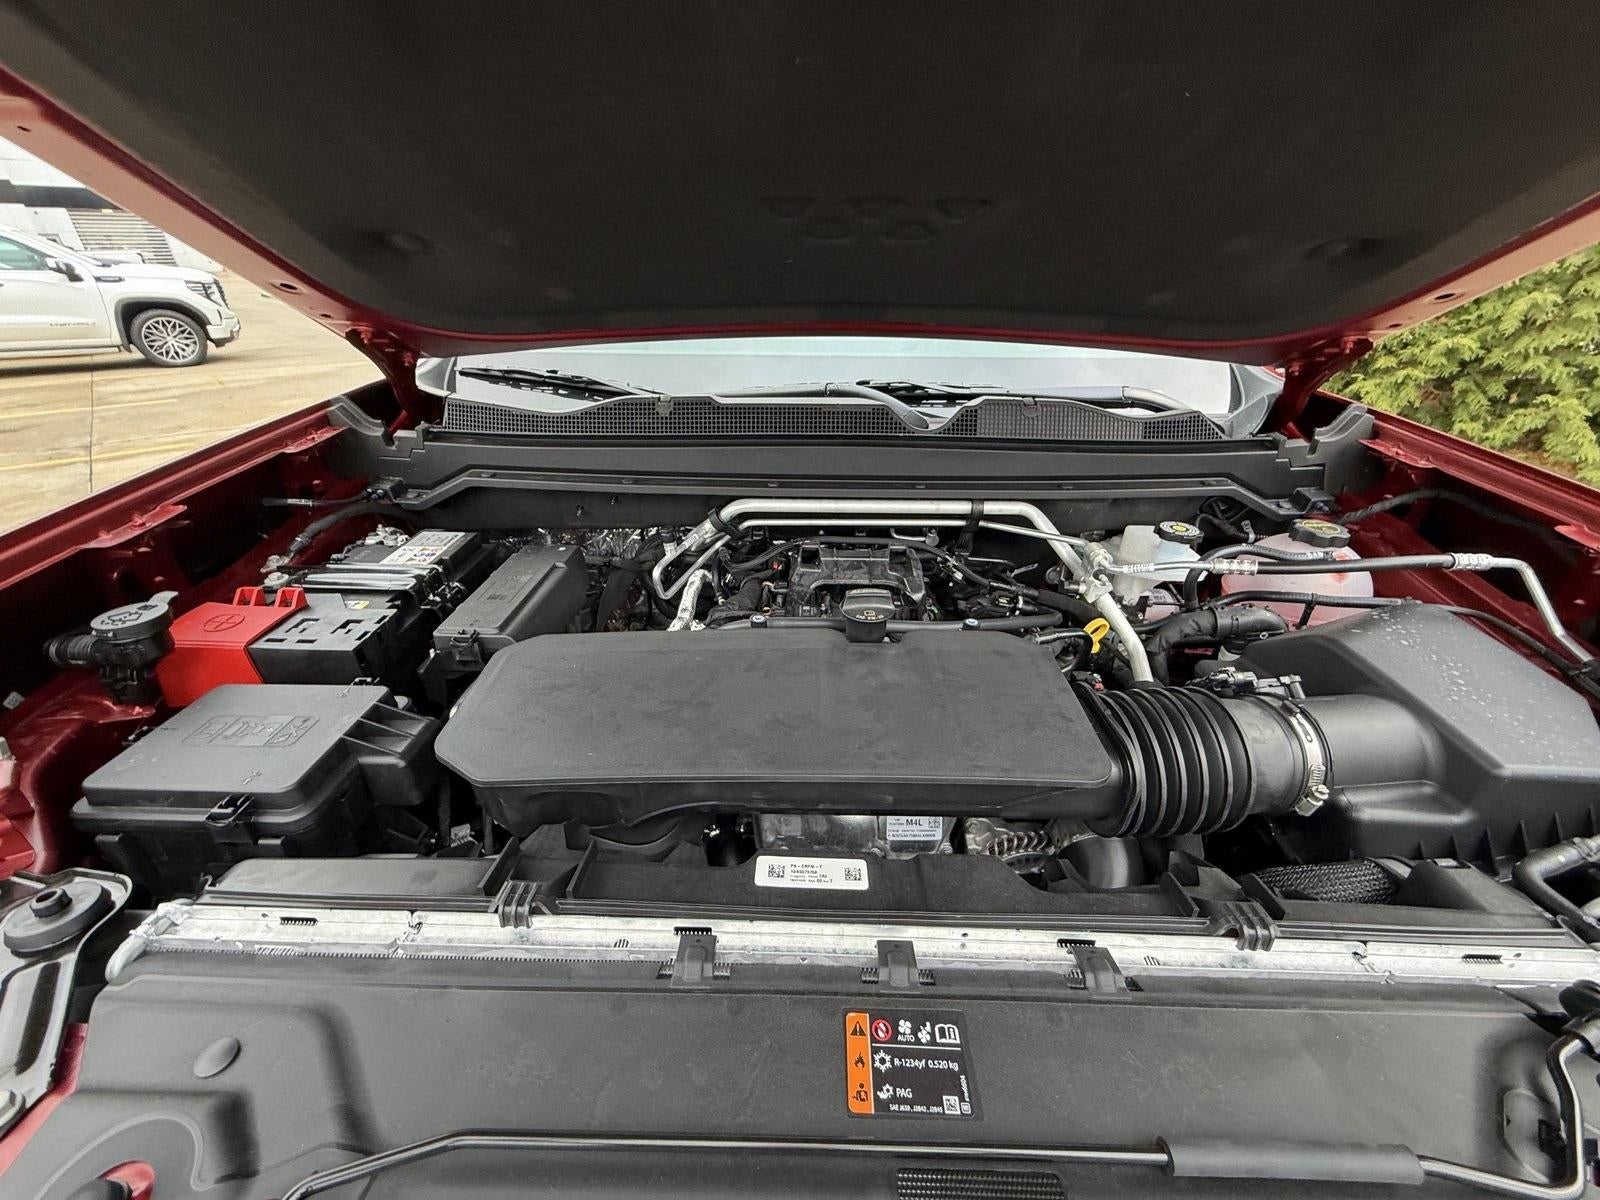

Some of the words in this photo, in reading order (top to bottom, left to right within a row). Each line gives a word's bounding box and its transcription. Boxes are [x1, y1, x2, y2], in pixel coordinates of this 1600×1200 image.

[905, 818, 923, 826] M4L
[897, 1034, 915, 1042] AUTO
[894, 1057, 926, 1070] R-1234yf
[928, 1059, 948, 1069] 0.520
[948, 1060, 959, 1072] kg
[896, 1087, 913, 1098] PAG
